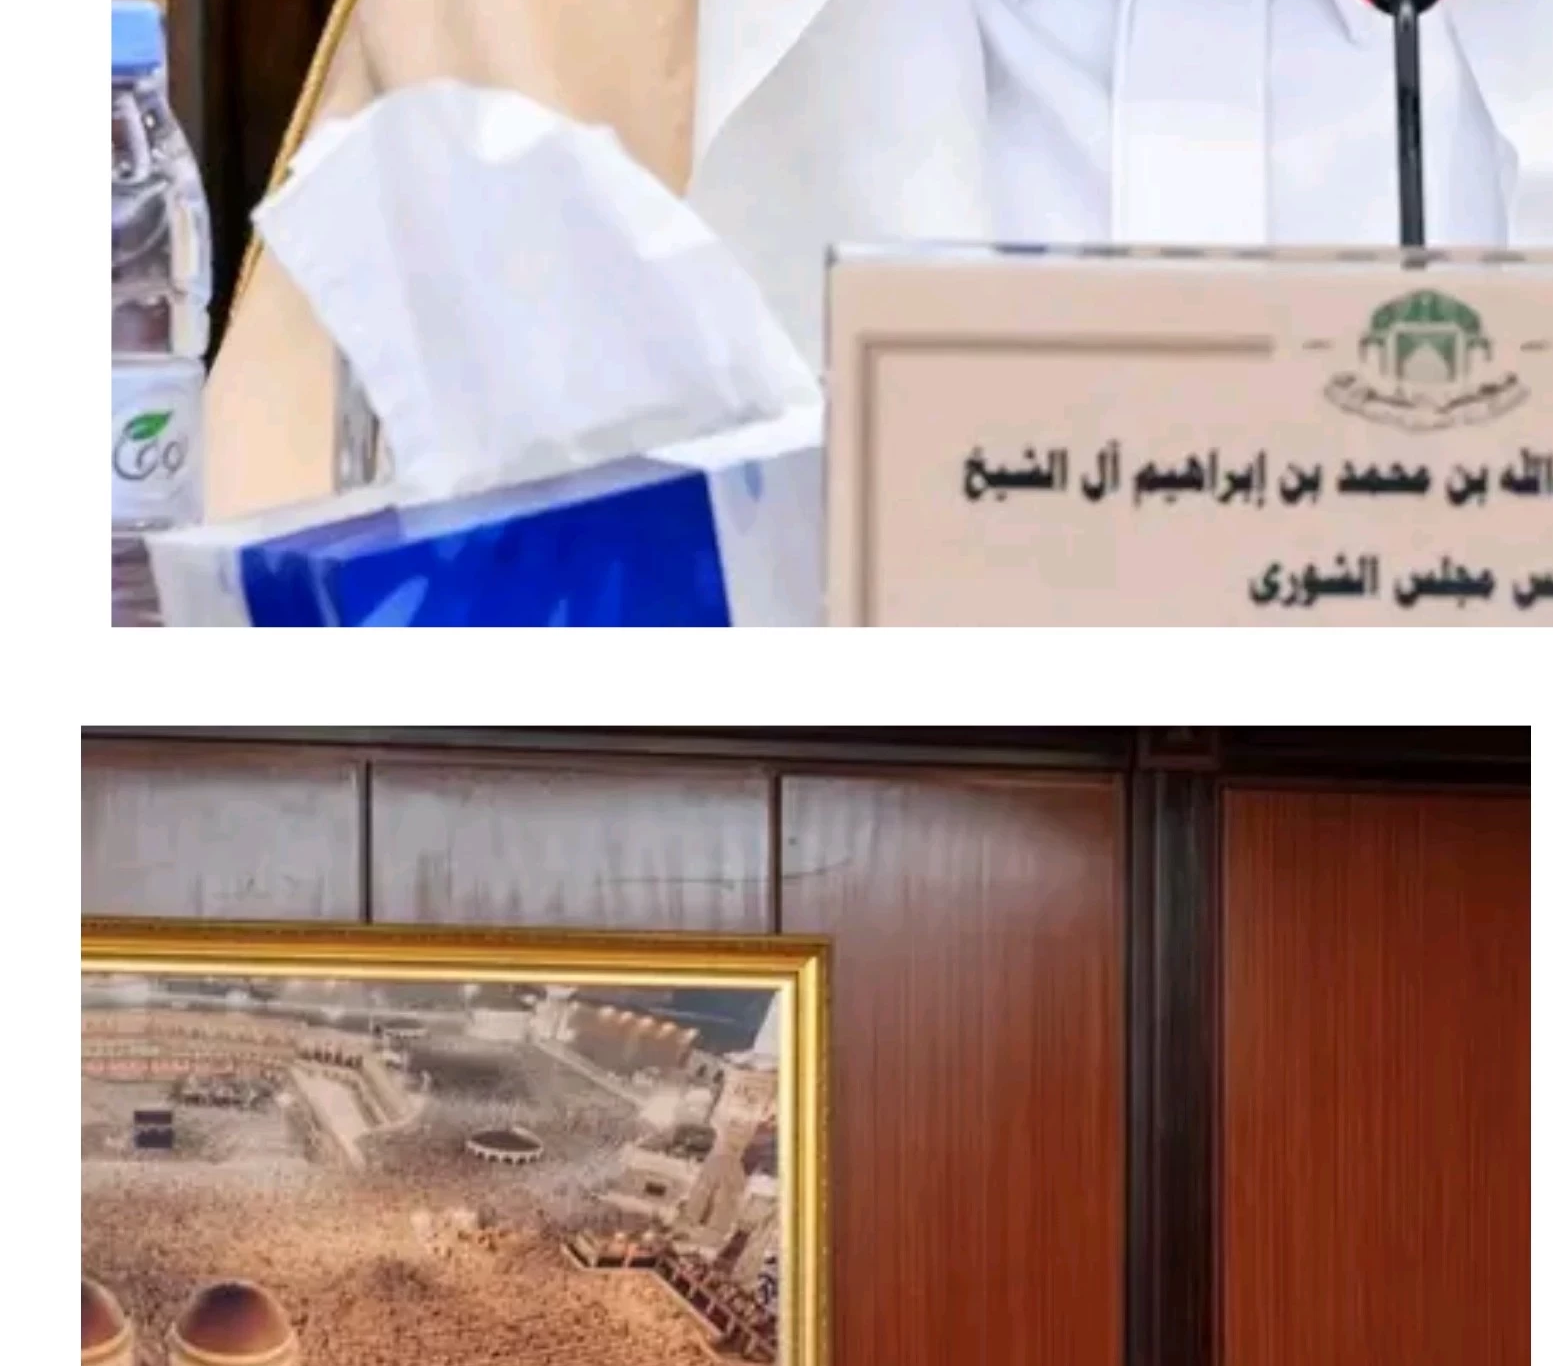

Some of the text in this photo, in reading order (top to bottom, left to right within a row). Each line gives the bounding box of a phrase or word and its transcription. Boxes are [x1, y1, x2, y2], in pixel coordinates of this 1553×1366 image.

[964, 449, 1068, 502] الشيخ
[1081, 441, 1120, 503] آل
[1133, 451, 1266, 508] إبراهيم
[1279, 464, 1323, 505] بن
[1337, 459, 1431, 497] محمد
[1445, 466, 1489, 507] بن
[1249, 554, 1379, 608] الشورى
[1394, 556, 1496, 609] مجلس
